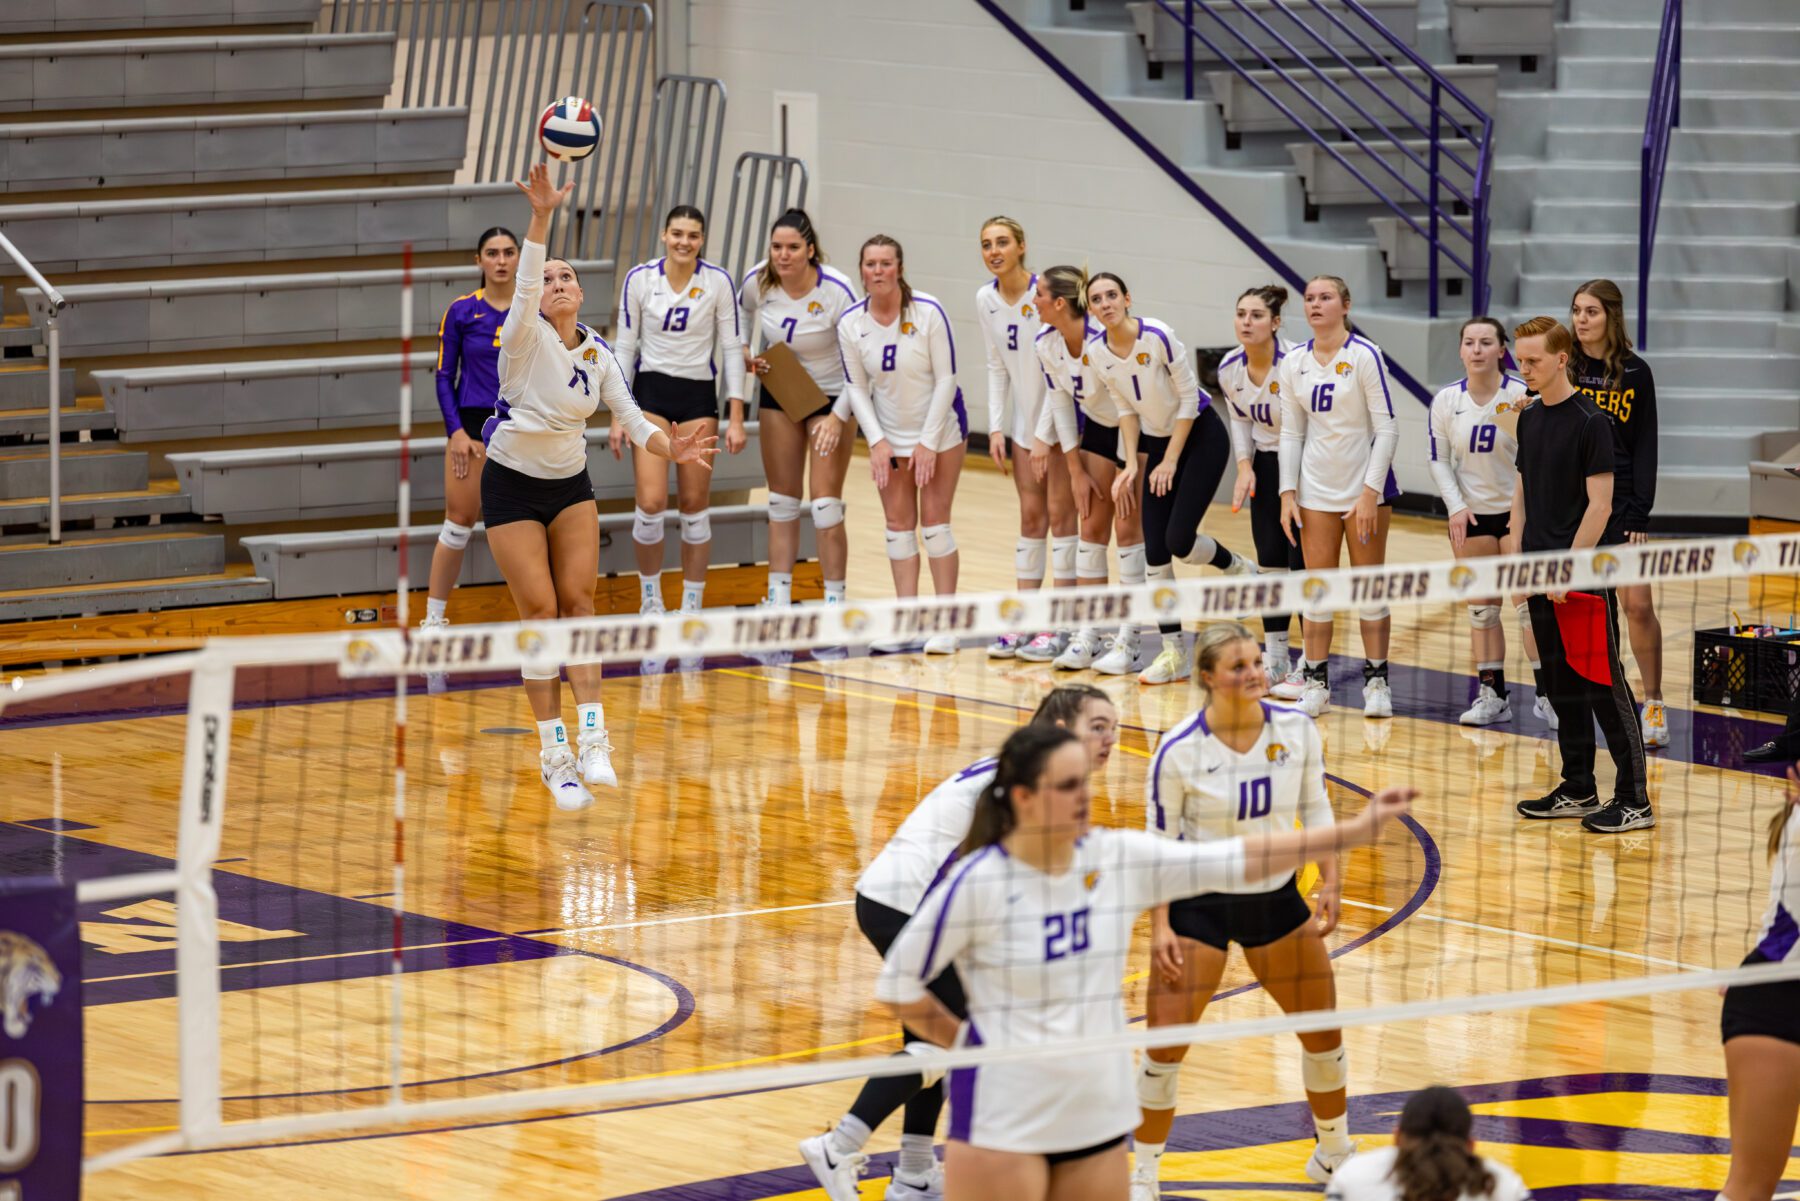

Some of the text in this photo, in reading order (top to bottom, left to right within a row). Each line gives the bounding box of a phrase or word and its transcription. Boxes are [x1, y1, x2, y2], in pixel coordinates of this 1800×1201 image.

[661, 307, 690, 332] 13
[781, 317, 798, 344] 7
[1007, 324, 1019, 351] 3
[881, 344, 897, 372] 8
[1131, 374, 1142, 401] 1
[1311, 383, 1335, 412] 16
[1249, 403, 1274, 427] 14
[1469, 424, 1497, 453] 19
[891, 602, 980, 635] TIGERS
[1048, 593, 1133, 625] TIGERS
[1200, 582, 1284, 613] TIGERS
[1350, 570, 1430, 602] TIGERS
[1495, 557, 1573, 588] TIGERS
[1638, 546, 1715, 577] TIGERS
[1779, 540, 1800, 568] TI
[1236, 775, 1272, 821] 10
[1043, 905, 1091, 962] 20
